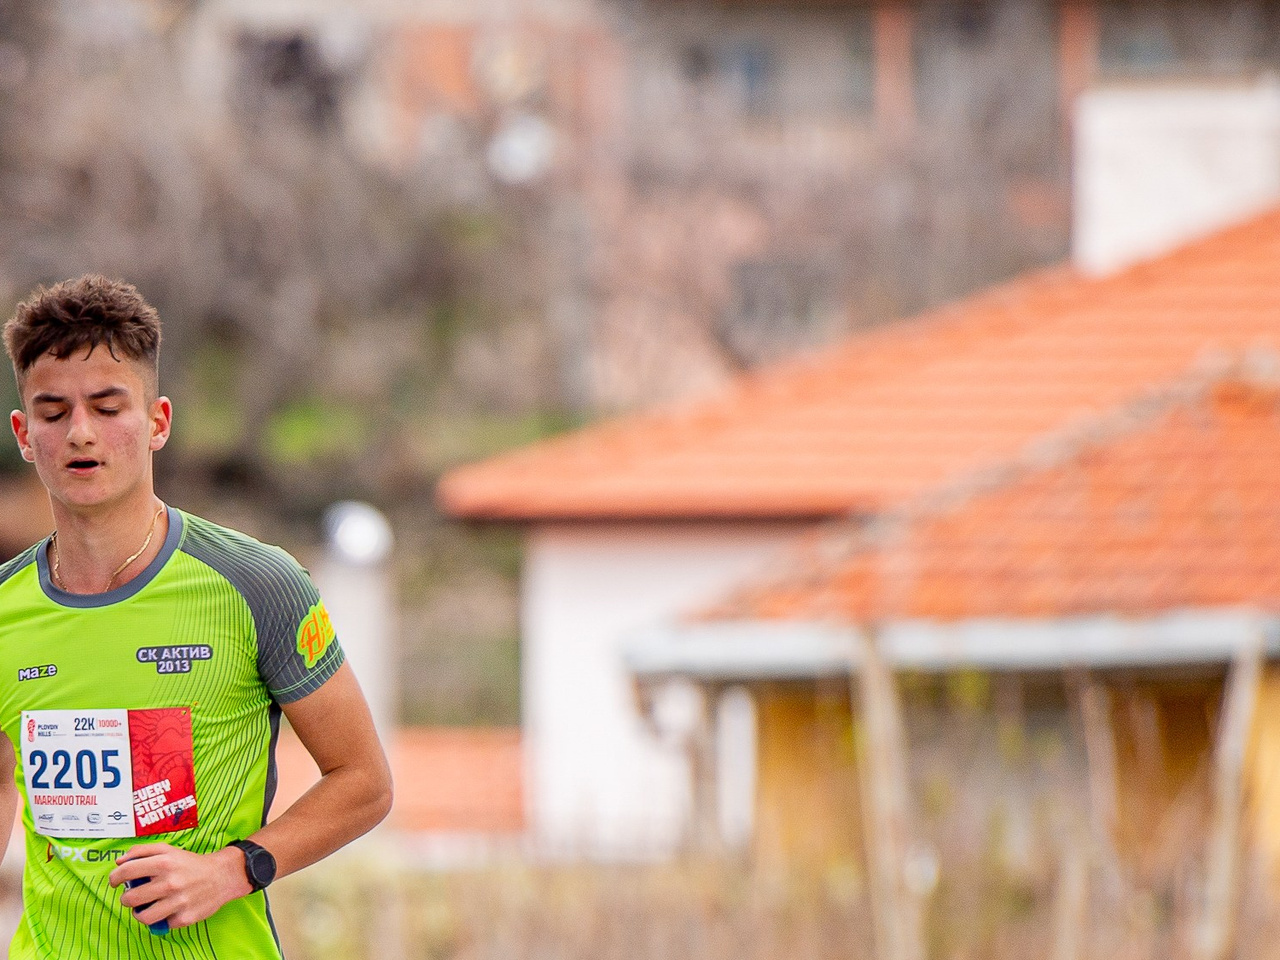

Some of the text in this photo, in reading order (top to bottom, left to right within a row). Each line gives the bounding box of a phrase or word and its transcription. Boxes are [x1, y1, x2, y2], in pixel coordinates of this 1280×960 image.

[137, 646, 211, 661] СК АКТИВ
[158, 660, 190, 673] 2013
[74, 717, 95, 731] 22K
[29, 749, 121, 789] 2205
[34, 795, 98, 805] MARKOVO TRAIL
[134, 794, 167, 816] STEP
[138, 794, 197, 828] MATTERS
